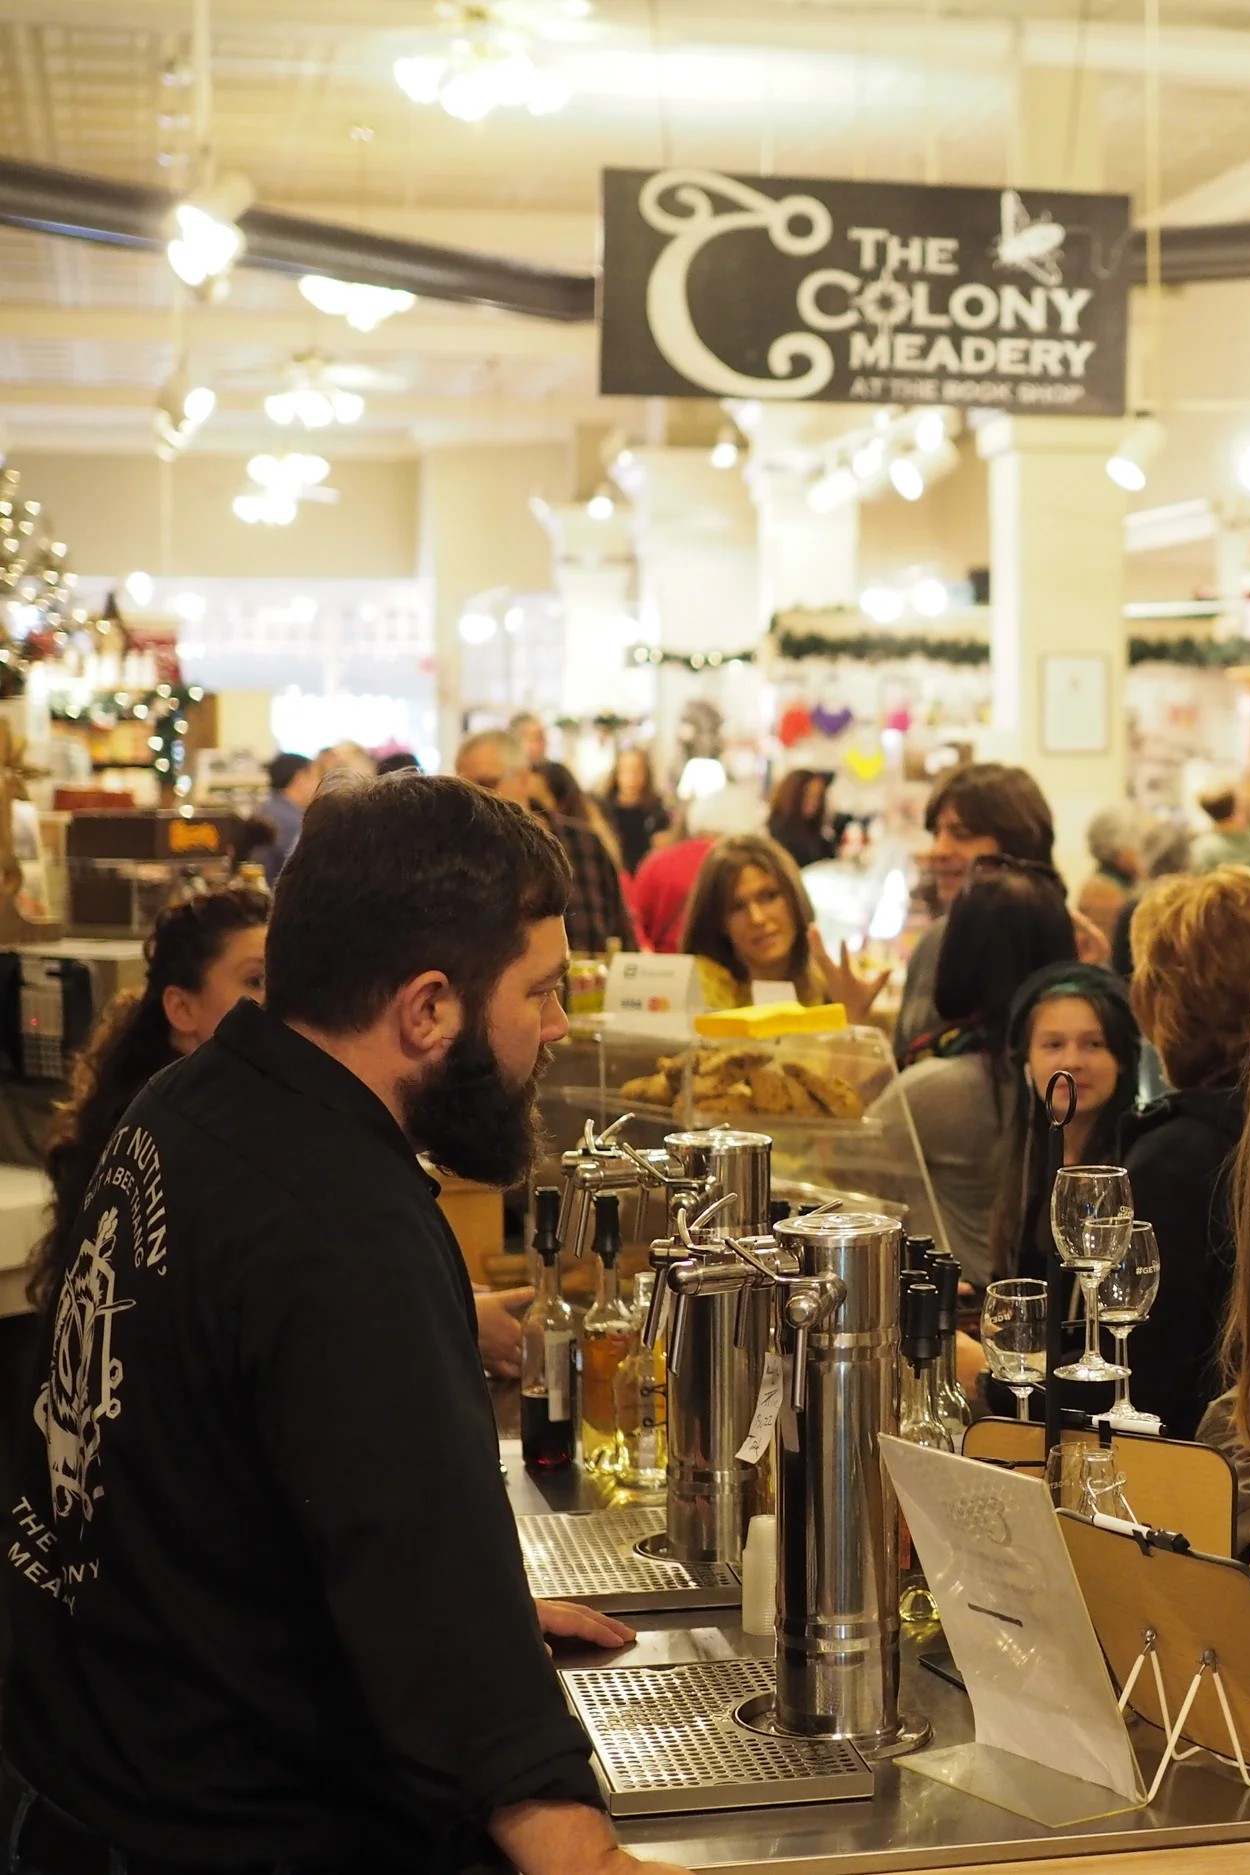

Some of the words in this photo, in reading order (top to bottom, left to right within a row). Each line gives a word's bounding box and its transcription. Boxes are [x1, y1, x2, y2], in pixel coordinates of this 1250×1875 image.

[847, 226, 960, 277] THE
[796, 267, 1094, 335] COLONY
[848, 331, 1097, 378] MEADERY
[850, 375, 885, 399] AT
[887, 376, 940, 400] THE
[941, 378, 1014, 402] BOOK
[1016, 381, 1086, 404] SHOP
[112, 1166, 135, 1196] BEE
[129, 1186, 144, 1268] THANG
[12, 1496, 58, 1553] THE
